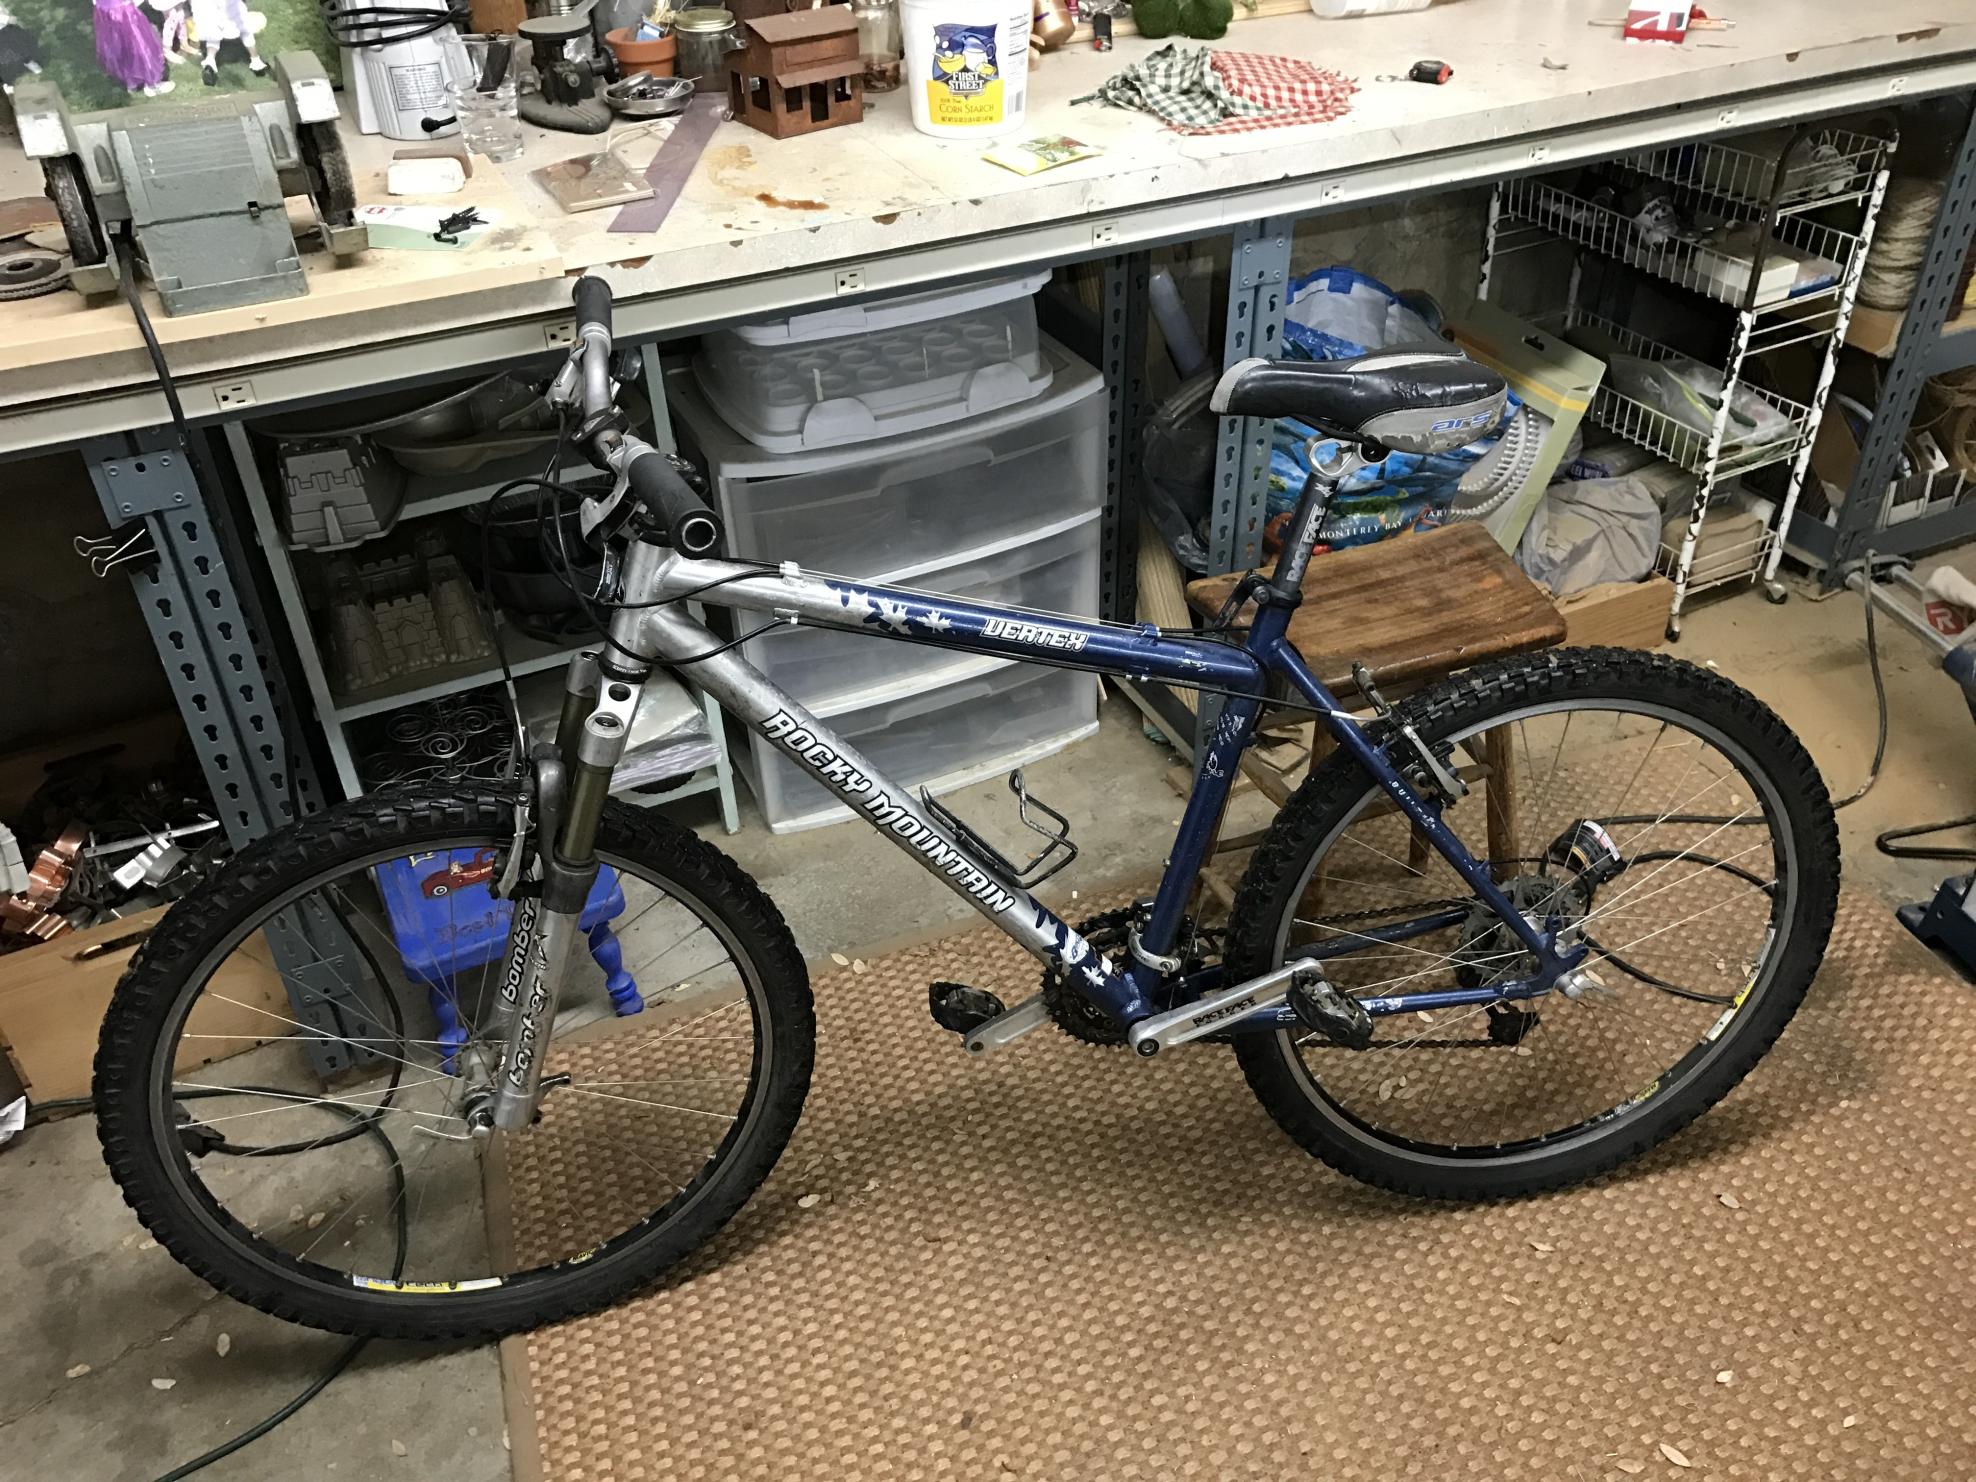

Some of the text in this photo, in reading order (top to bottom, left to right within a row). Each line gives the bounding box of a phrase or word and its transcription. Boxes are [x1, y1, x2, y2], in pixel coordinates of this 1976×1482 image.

[948, 80, 985, 90] STREET
[952, 71, 980, 81] FIRST
[940, 104, 994, 113] CORN STARCH
[1302, 503, 1326, 544] FACE
[1385, 519, 1403, 531] BAY
[981, 618, 1089, 652] VERTEX
[761, 709, 1016, 914] ROCKY MOUNTAIN
[501, 897, 537, 1004] bomber
[1193, 996, 1255, 1024] RACE FACE
